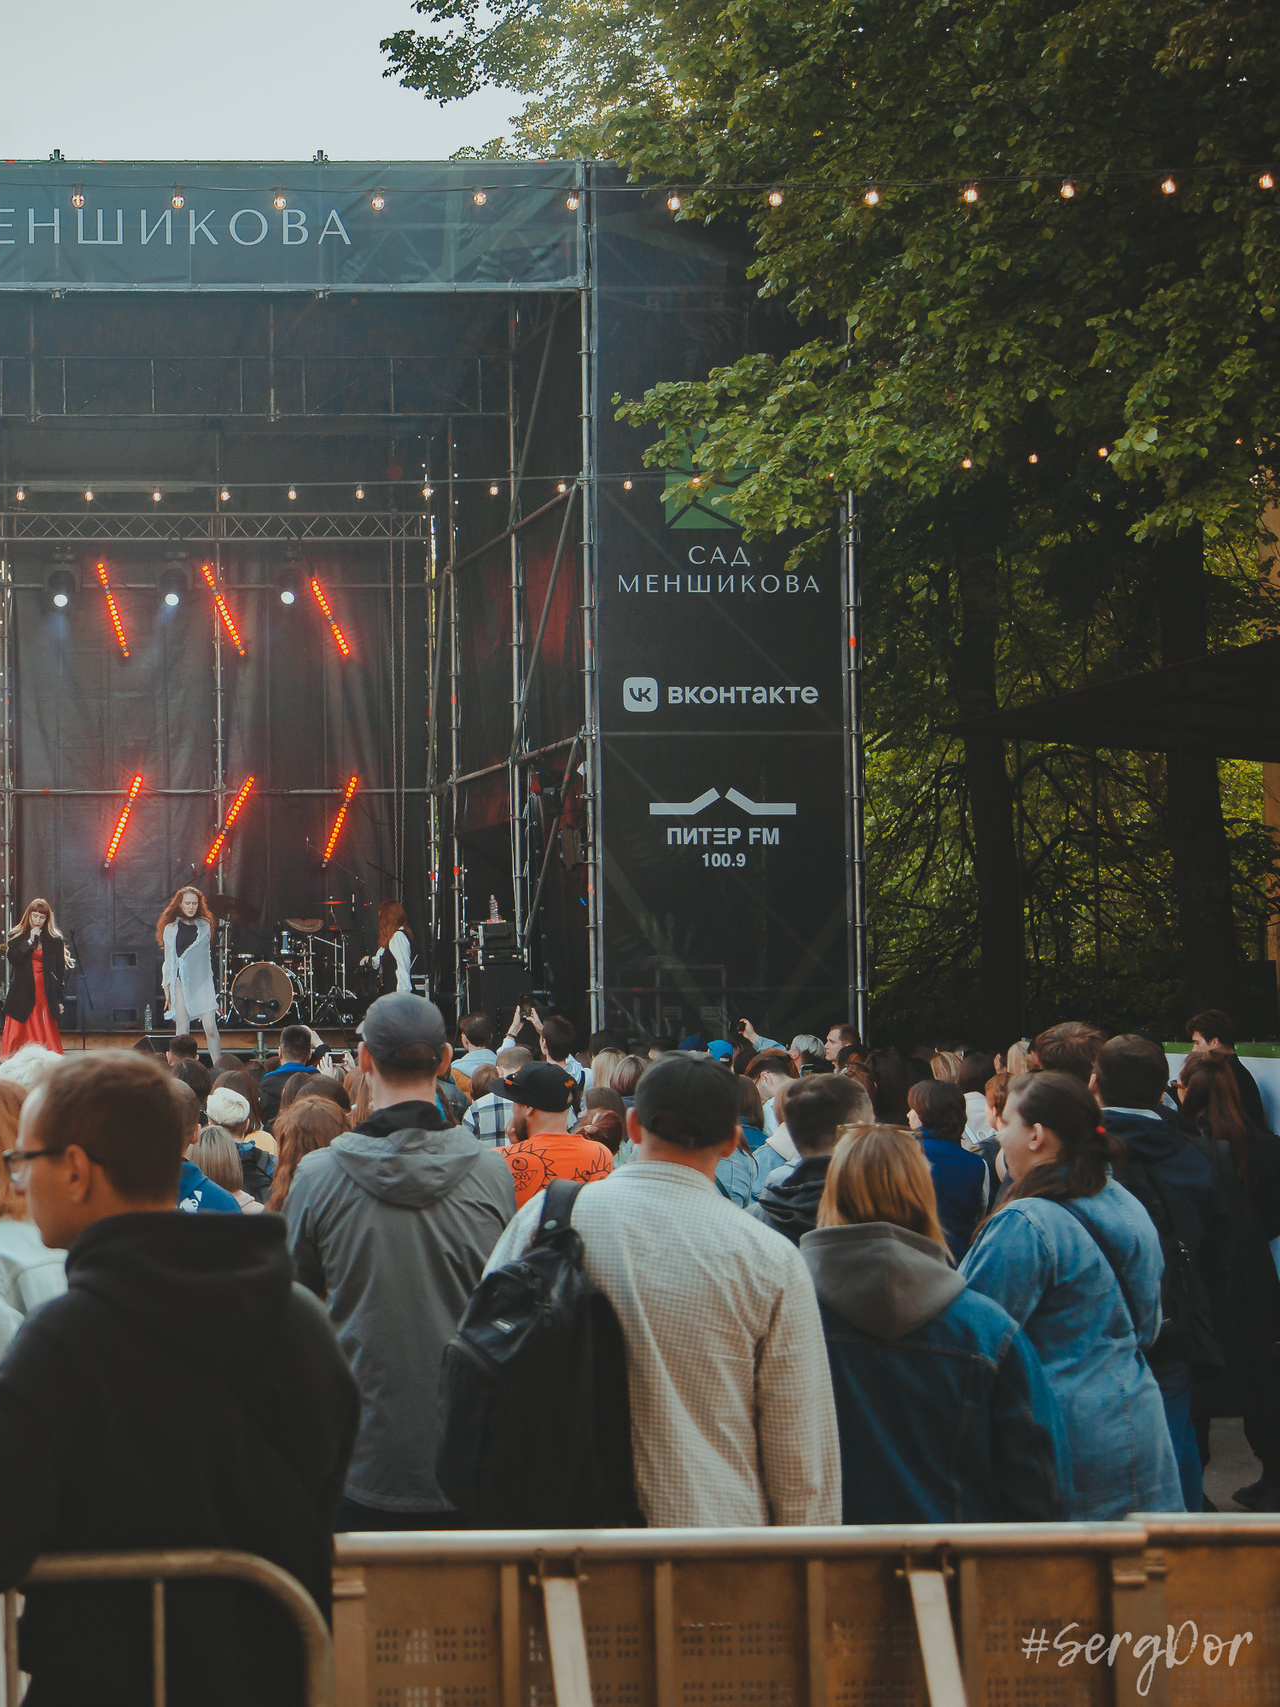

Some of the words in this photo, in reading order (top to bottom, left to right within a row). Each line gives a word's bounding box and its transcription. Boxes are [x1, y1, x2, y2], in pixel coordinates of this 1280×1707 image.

[688, 545, 751, 567] САД
[618, 574, 820, 594] МЕНШИКОВА
[667, 827, 742, 845] ПИТЕР
[748, 827, 780, 845] FM
[701, 852, 746, 868] 100.9
